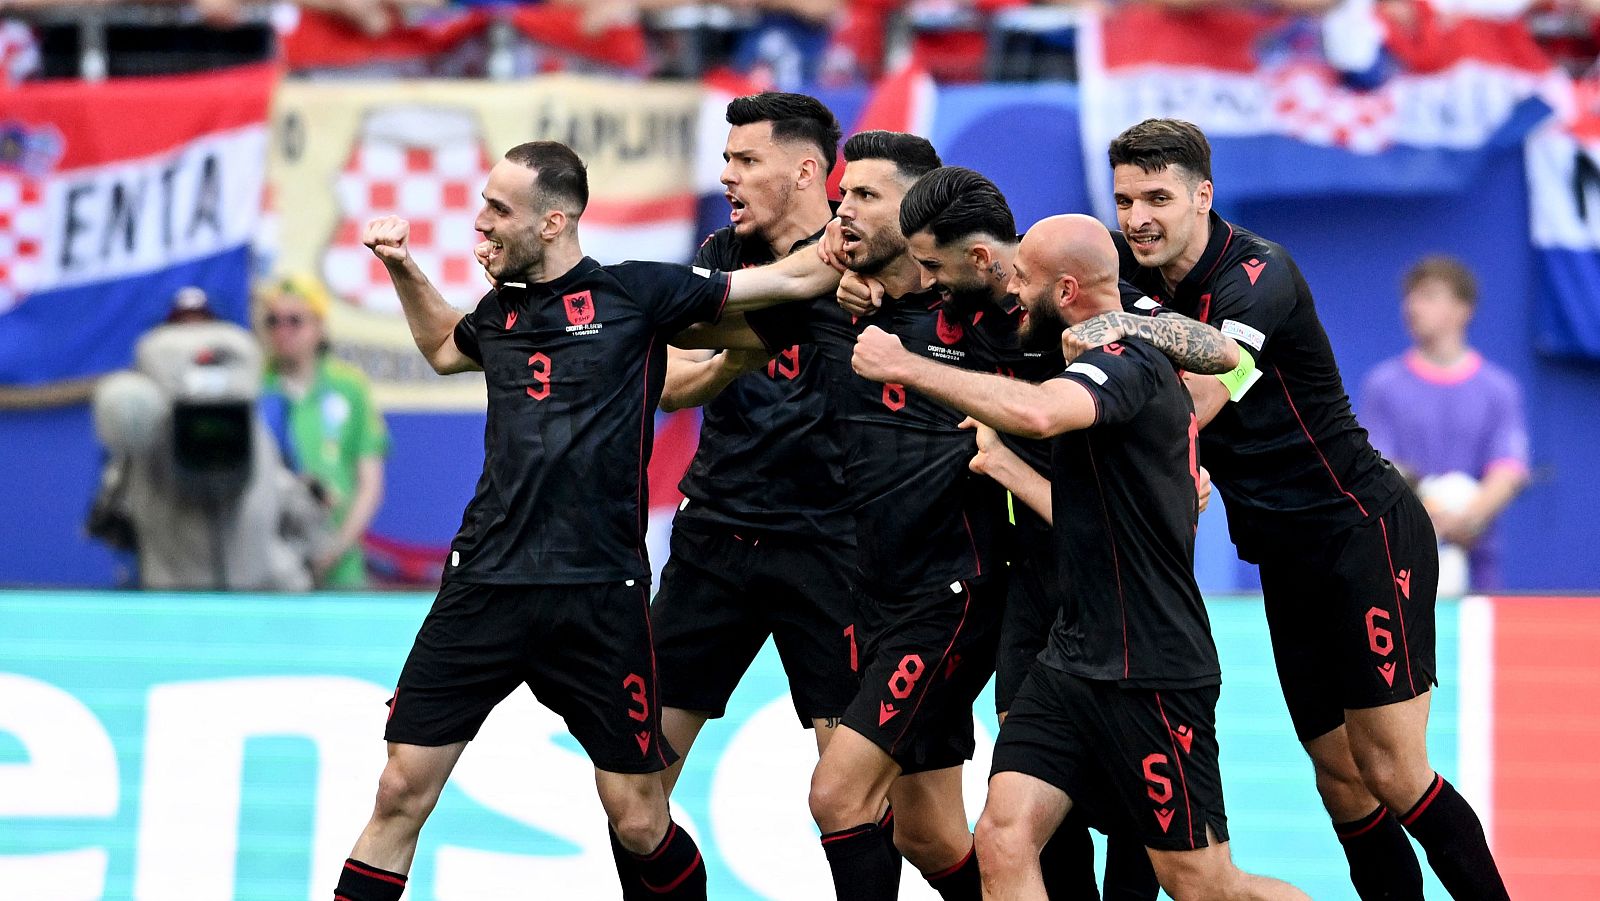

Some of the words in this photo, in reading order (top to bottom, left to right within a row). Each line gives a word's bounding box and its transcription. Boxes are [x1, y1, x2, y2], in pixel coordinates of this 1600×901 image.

[526, 352, 552, 401] 3
[1364, 606, 1394, 657] 6
[622, 672, 650, 722] 3
[887, 654, 926, 699] 8
[1142, 753, 1173, 805] 5
